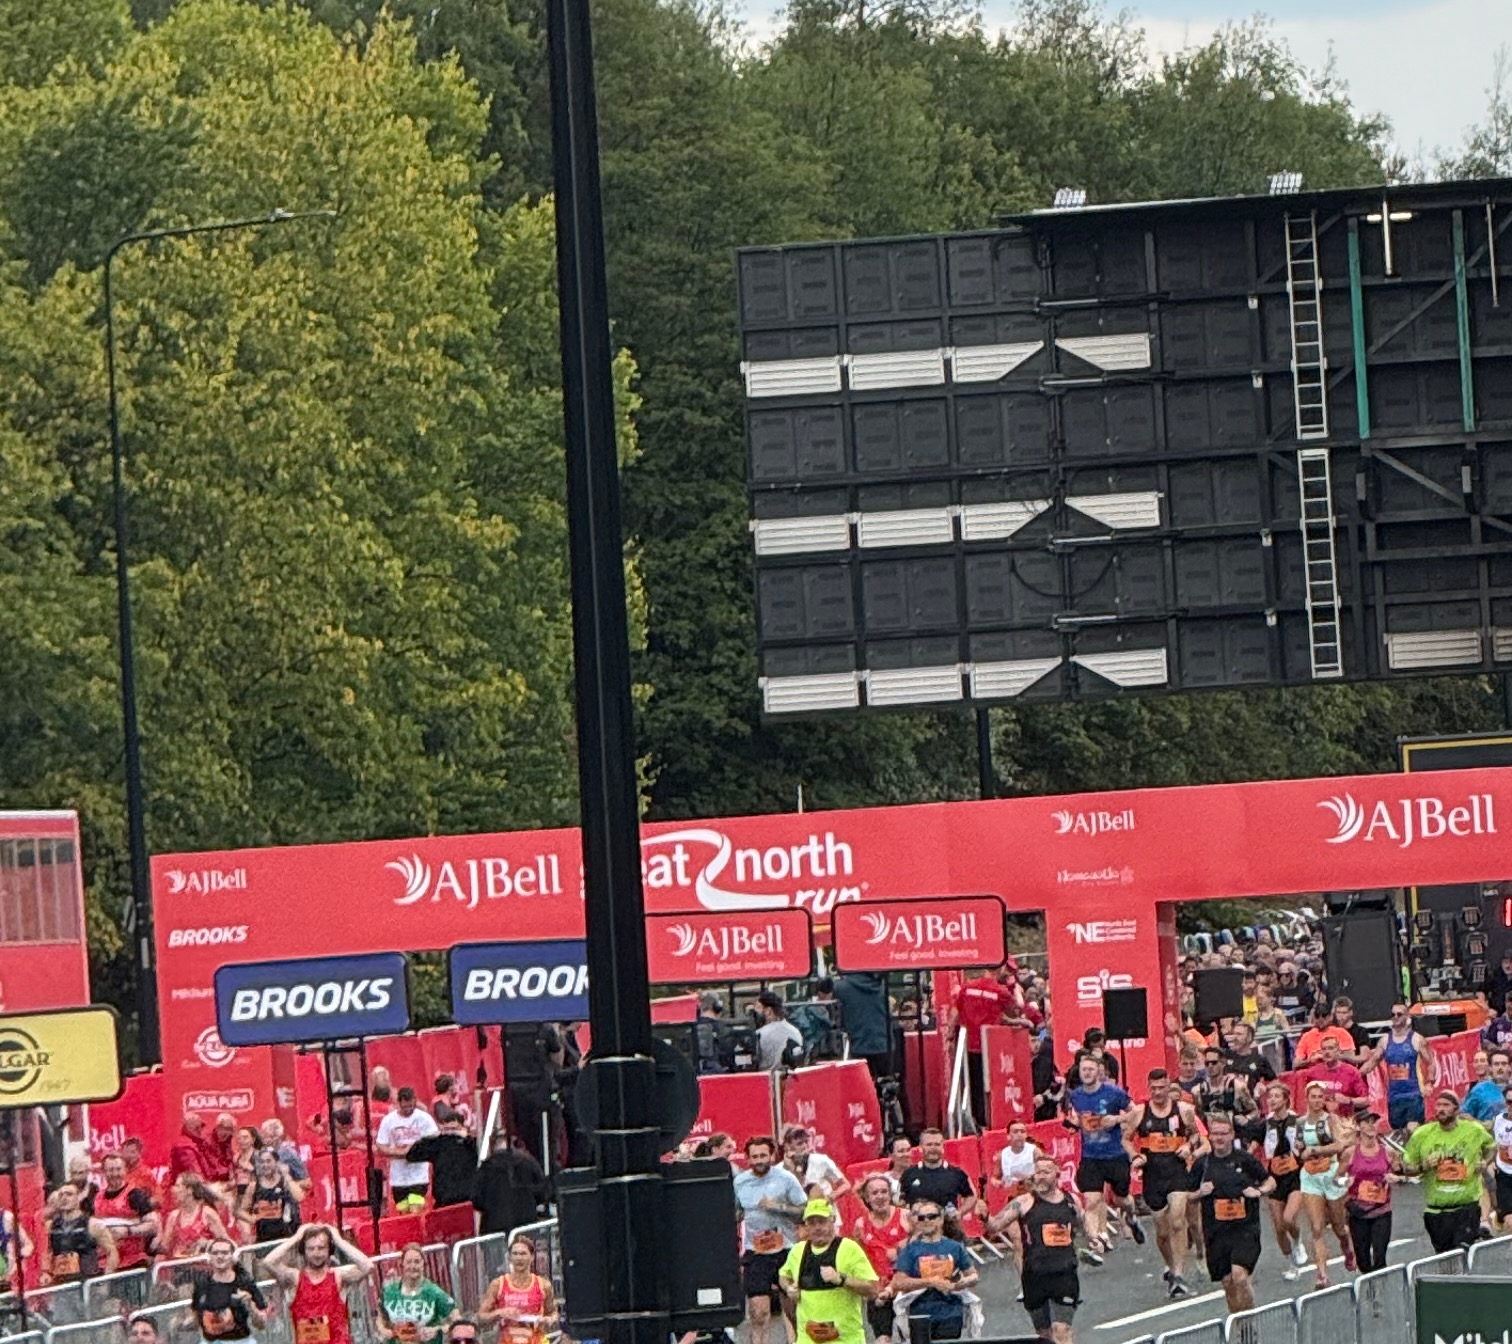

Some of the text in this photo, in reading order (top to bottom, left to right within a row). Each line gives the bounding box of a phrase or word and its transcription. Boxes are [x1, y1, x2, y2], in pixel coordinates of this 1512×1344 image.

[1363, 794, 1498, 848] AJBell
[735, 831, 854, 882] north
[431, 853, 564, 909] AJBell
[167, 925, 250, 948] BROOKS
[230, 977, 394, 1023] BROOKS
[463, 964, 589, 1001] BROO
